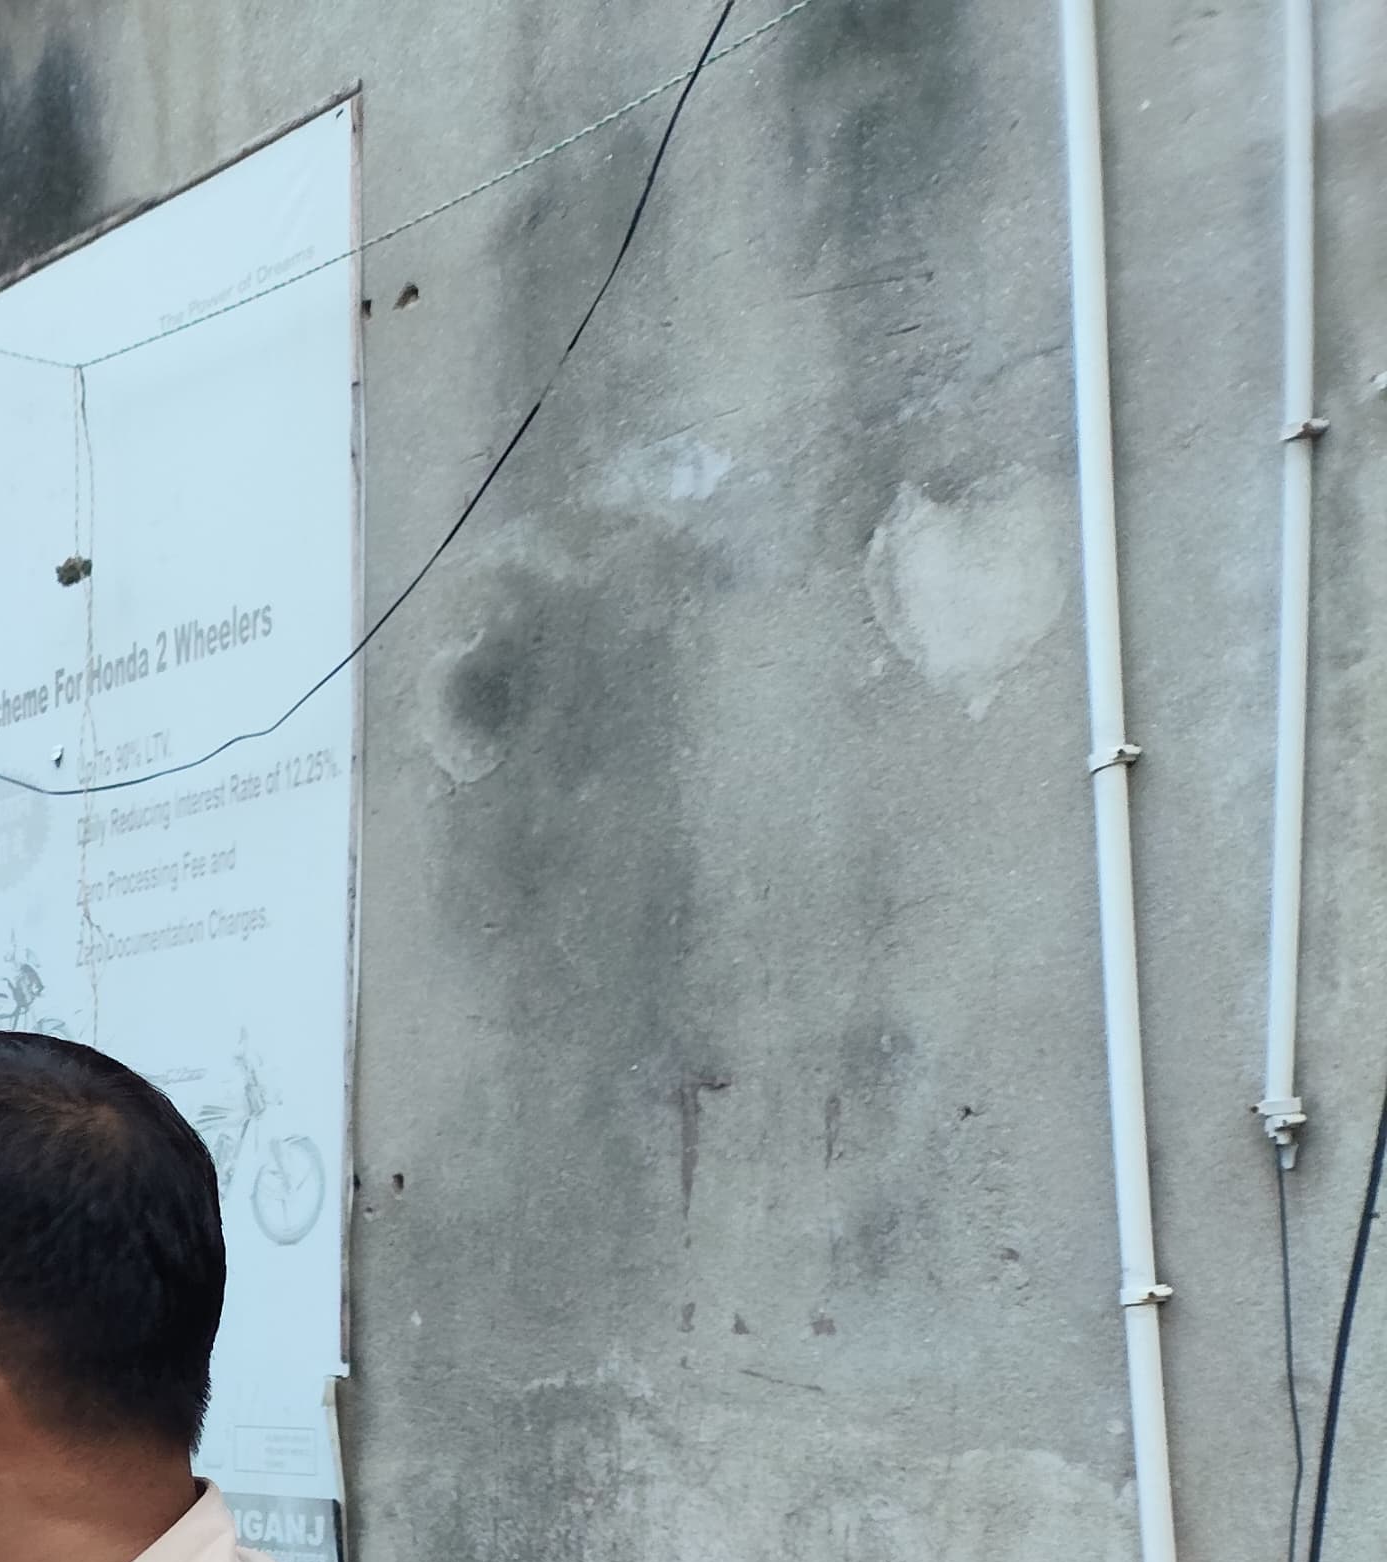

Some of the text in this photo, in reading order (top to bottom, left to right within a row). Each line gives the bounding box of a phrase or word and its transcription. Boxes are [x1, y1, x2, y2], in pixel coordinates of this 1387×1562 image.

[158, 311, 185, 331] The
[256, 244, 316, 285] Dreams
[54, 666, 84, 709] For
[85, 641, 151, 698] Honda
[155, 630, 169, 674] 2
[173, 602, 275, 668] Wheelers
[230, 773, 262, 803] Rate
[264, 762, 281, 795] of
[107, 864, 179, 897] Processing
[182, 851, 207, 880] Fee
[210, 840, 236, 873] and
